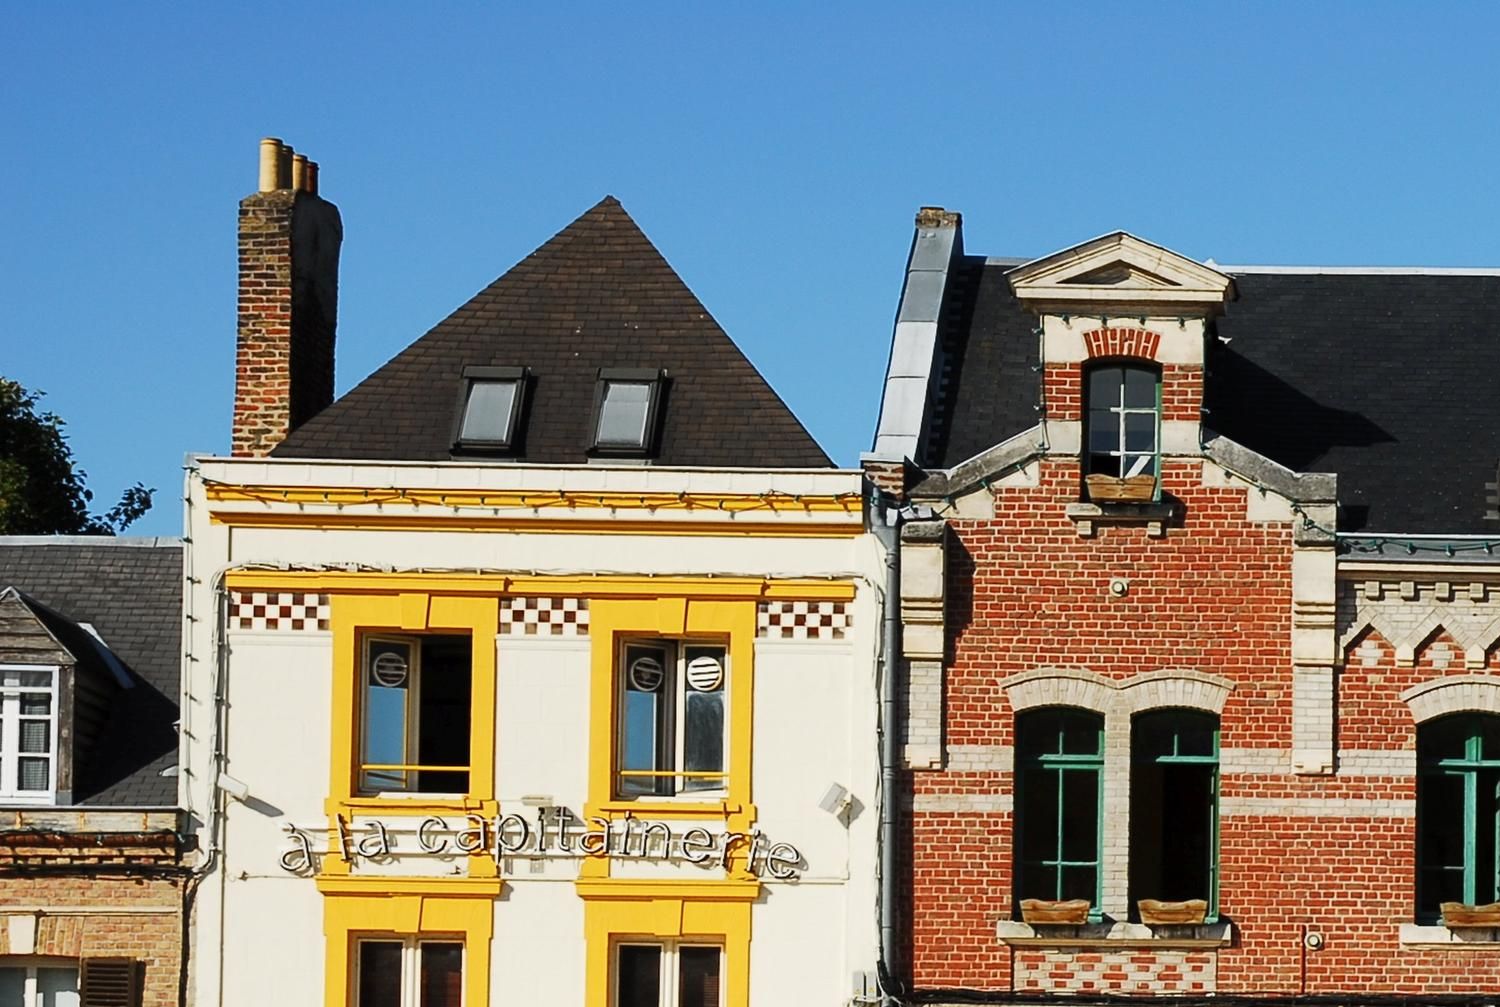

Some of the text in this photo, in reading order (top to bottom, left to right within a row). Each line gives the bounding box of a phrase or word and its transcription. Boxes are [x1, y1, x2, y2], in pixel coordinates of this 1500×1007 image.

[280, 804, 802, 879] à la capitainerie
